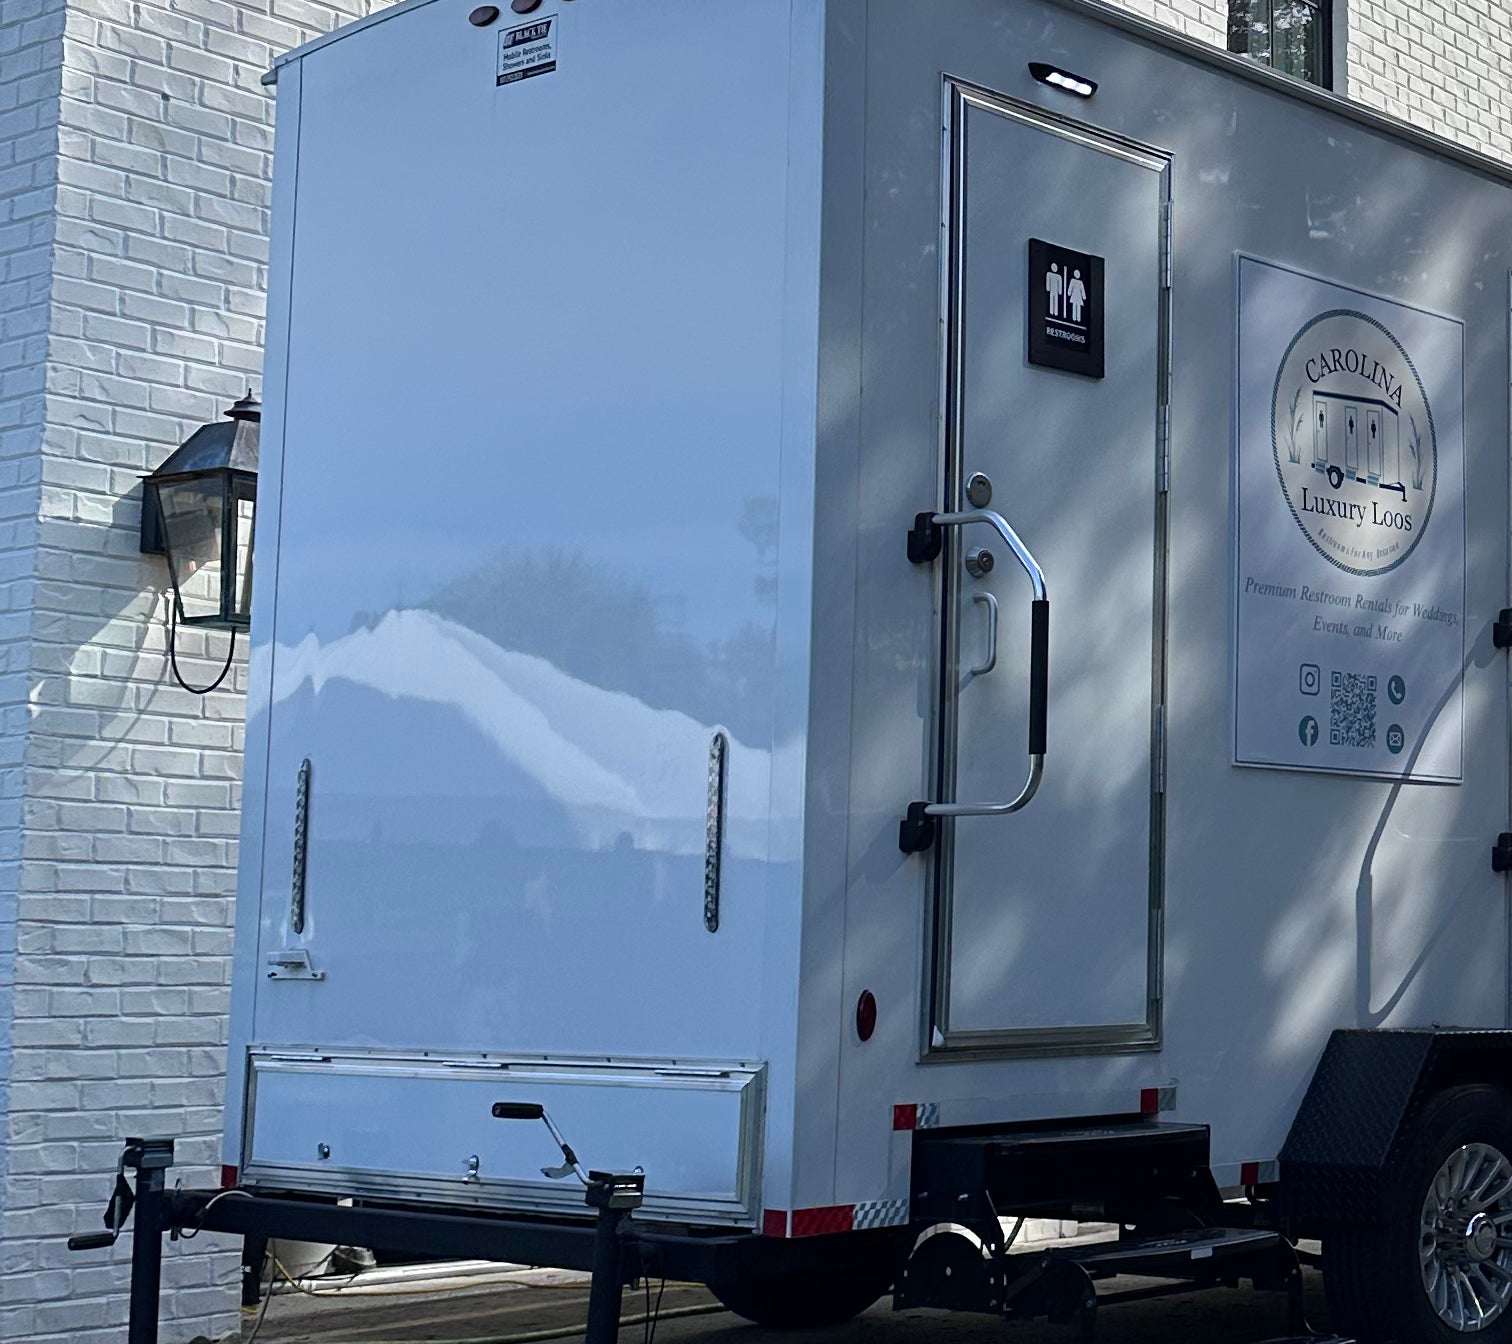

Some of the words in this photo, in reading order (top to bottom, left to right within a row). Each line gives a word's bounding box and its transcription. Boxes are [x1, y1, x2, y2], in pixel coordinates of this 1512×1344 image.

[525, 55, 536, 65] and
[1305, 348, 1403, 409] CAROLINA
[1301, 487, 1367, 528] Luxury
[1371, 501, 1413, 532] Loos
[1244, 576, 1297, 599] Premium
[1299, 585, 1352, 608] Restroom
[1354, 593, 1393, 614] Rentals
[1392, 600, 1410, 618] for
[1312, 615, 1350, 637] Events,
[1353, 622, 1374, 639] and
[1375, 624, 1404, 642] More
